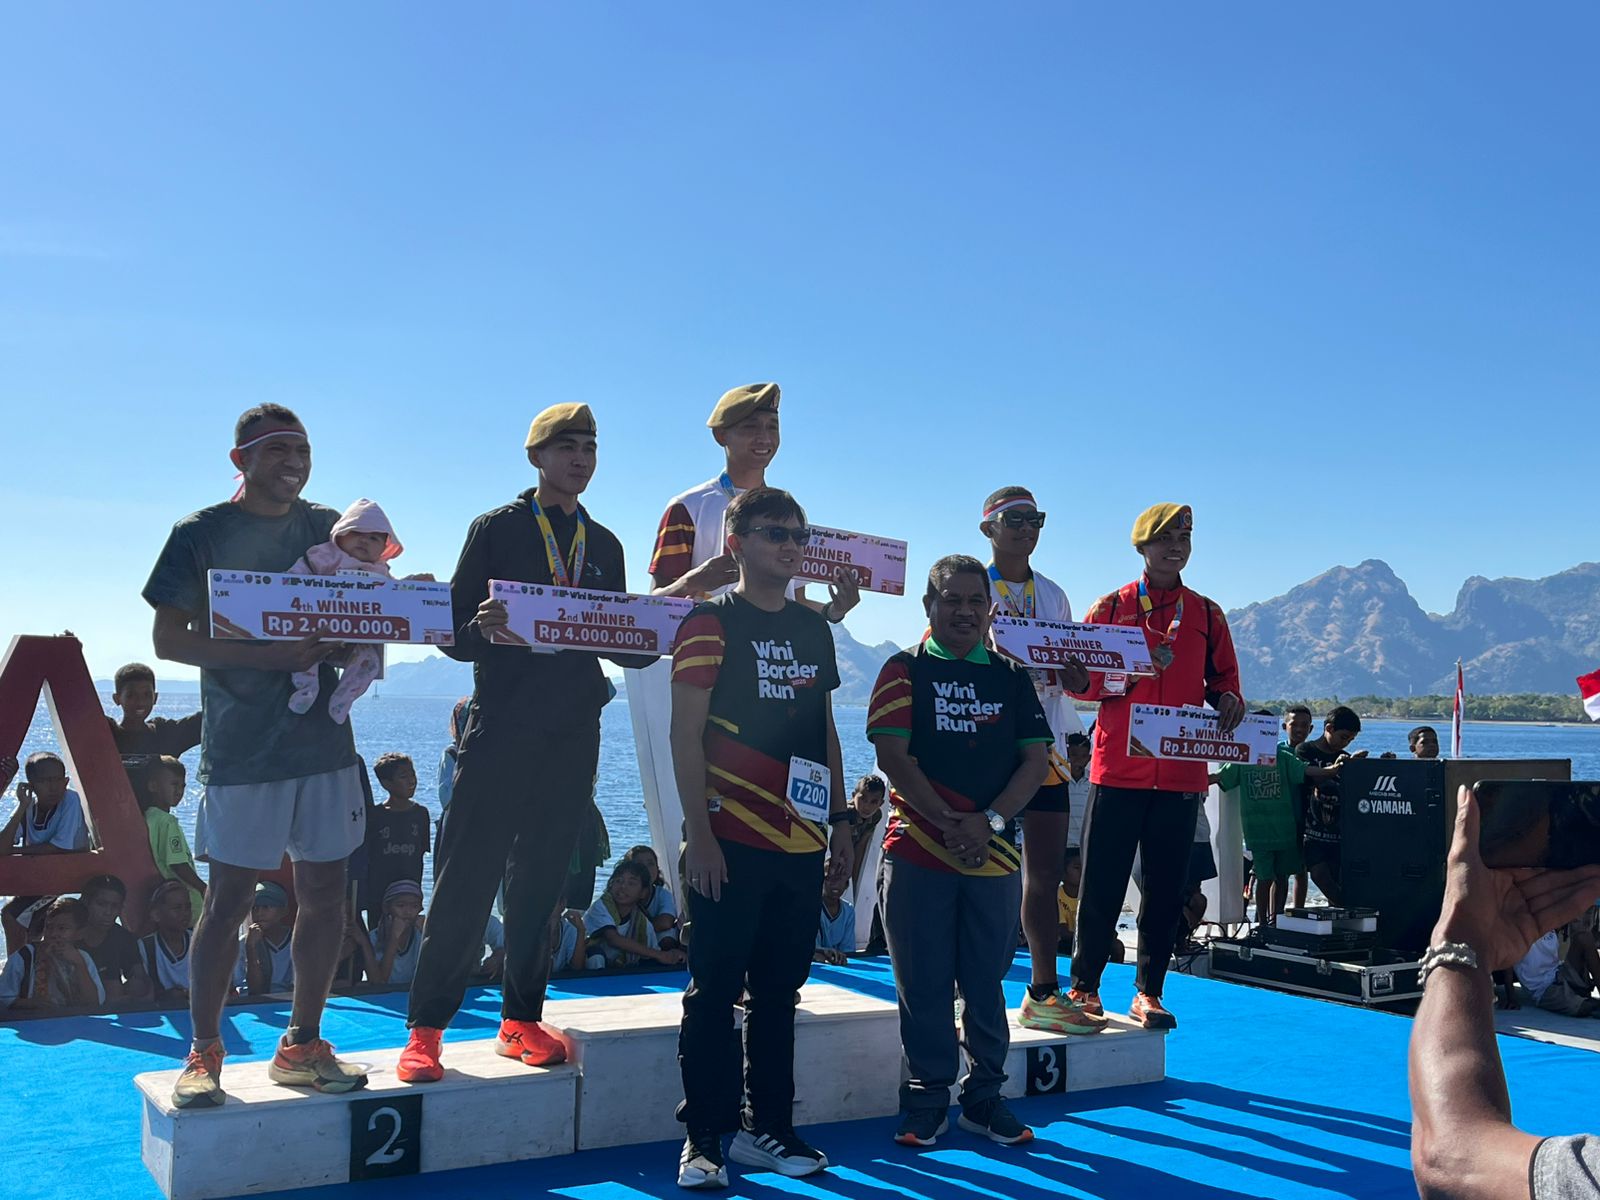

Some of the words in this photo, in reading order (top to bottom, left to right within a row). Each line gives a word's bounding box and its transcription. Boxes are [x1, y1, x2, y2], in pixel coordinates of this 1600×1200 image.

[803, 545, 852, 563] WINNER
[802, 560, 869, 585] 000.00,-
[303, 578, 323, 588] Wini
[325, 580, 355, 589] Border
[570, 591, 586, 600] Wini
[587, 594, 613, 602] Border
[290, 597, 313, 613] 4th
[317, 600, 383, 615] WINNER
[268, 616, 294, 634] Rp
[557, 608, 578, 622] 2nd
[581, 611, 635, 627] WINNER
[539, 624, 560, 642] Rp
[564, 629, 655, 649] 4.000.000,-
[1043, 635, 1059, 646] 3rd
[1060, 638, 1103, 651] WINNER
[751, 640, 794, 661] Wini
[1032, 649, 1050, 663] Rp
[1052, 650, 1121, 668] 3000.000,-
[756, 659, 819, 680] Border
[758, 679, 795, 700] Run
[932, 681, 976, 699] Wini
[935, 698, 1003, 716] Border
[936, 714, 977, 732] Run
[1179, 726, 1194, 738] 5th
[1195, 729, 1235, 742] WINNER
[1163, 740, 1179, 755] Rp
[1182, 742, 1248, 760] 1.000.000,-
[796, 781, 825, 806] 7200
[1370, 800, 1412, 815] YAMAHA
[383, 841, 416, 856] Jeep
[1034, 1046, 1061, 1092] 3
[364, 1105, 406, 1167] 2
